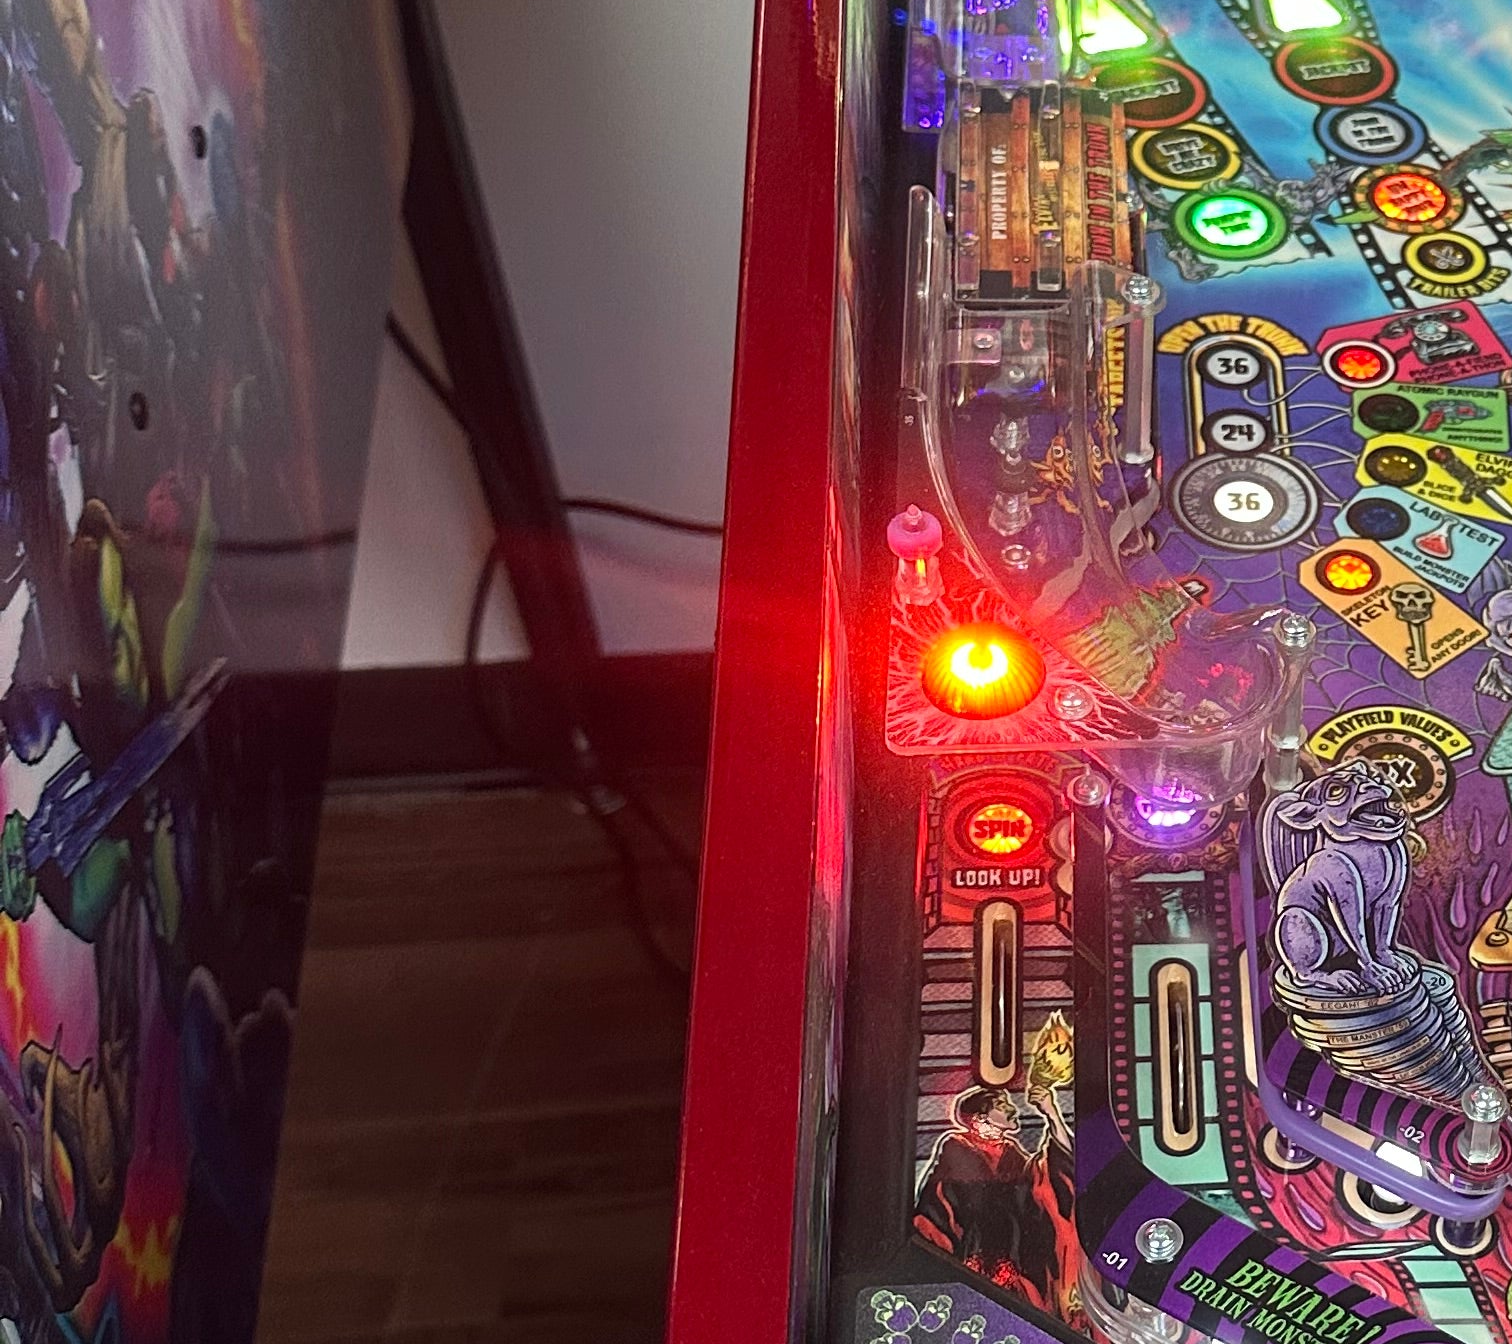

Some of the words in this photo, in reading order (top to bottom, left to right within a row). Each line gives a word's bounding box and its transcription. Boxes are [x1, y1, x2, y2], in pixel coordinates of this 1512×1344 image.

[1086, 122, 1109, 168] TRUNK
[1087, 171, 1113, 201] THE
[991, 166, 1008, 241] PROPERTY
[1198, 314, 1243, 333] THE
[1217, 358, 1249, 375] 36
[1221, 423, 1256, 442] 24
[1227, 493, 1260, 511] 36
[1409, 500, 1441, 523] LAB
[1458, 523, 1499, 548] TEST
[1350, 601, 1391, 628] KEY
[1321, 710, 1394, 744] PLAYFIELD
[1399, 711, 1454, 743] VALUES
[973, 817, 1026, 840] SPIN
[954, 868, 1003, 887] LOOK
[1007, 867, 1042, 886] UP!
[1425, 977, 1447, 988] -20
[1400, 1124, 1425, 1144] -02
[1100, 1251, 1128, 1270] -01
[1179, 1270, 1253, 1321] DRAIN
